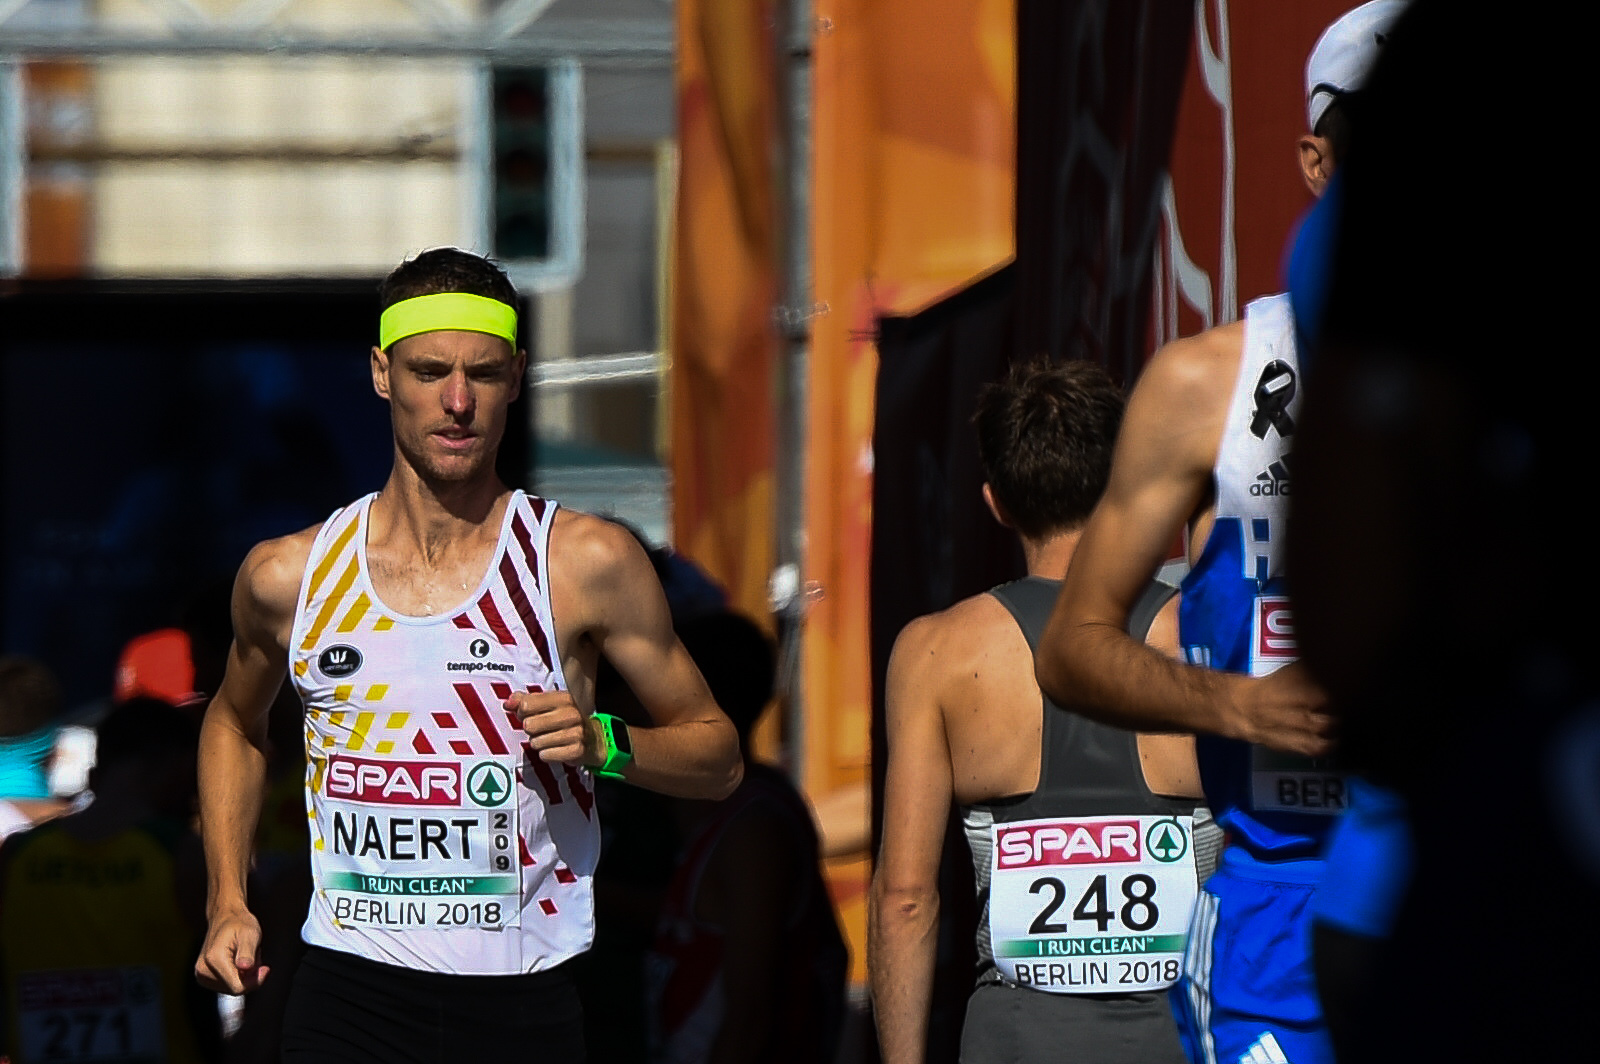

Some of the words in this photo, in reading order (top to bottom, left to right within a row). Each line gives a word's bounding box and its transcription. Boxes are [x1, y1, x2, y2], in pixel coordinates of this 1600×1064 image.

[446, 662, 515, 674] tempo-team
[329, 761, 458, 800] SPAR
[333, 811, 479, 860] NAERT
[1000, 825, 1138, 865] SPAR
[368, 878, 403, 893] RUN
[335, 898, 427, 926] BERLIN
[437, 902, 501, 926] 2018
[1028, 873, 1160, 935] 248
[1048, 939, 1086, 955] RUN
[1015, 962, 1108, 986] BERLIN
[1118, 960, 1179, 984] 2018
[42, 1010, 132, 1059] 271
